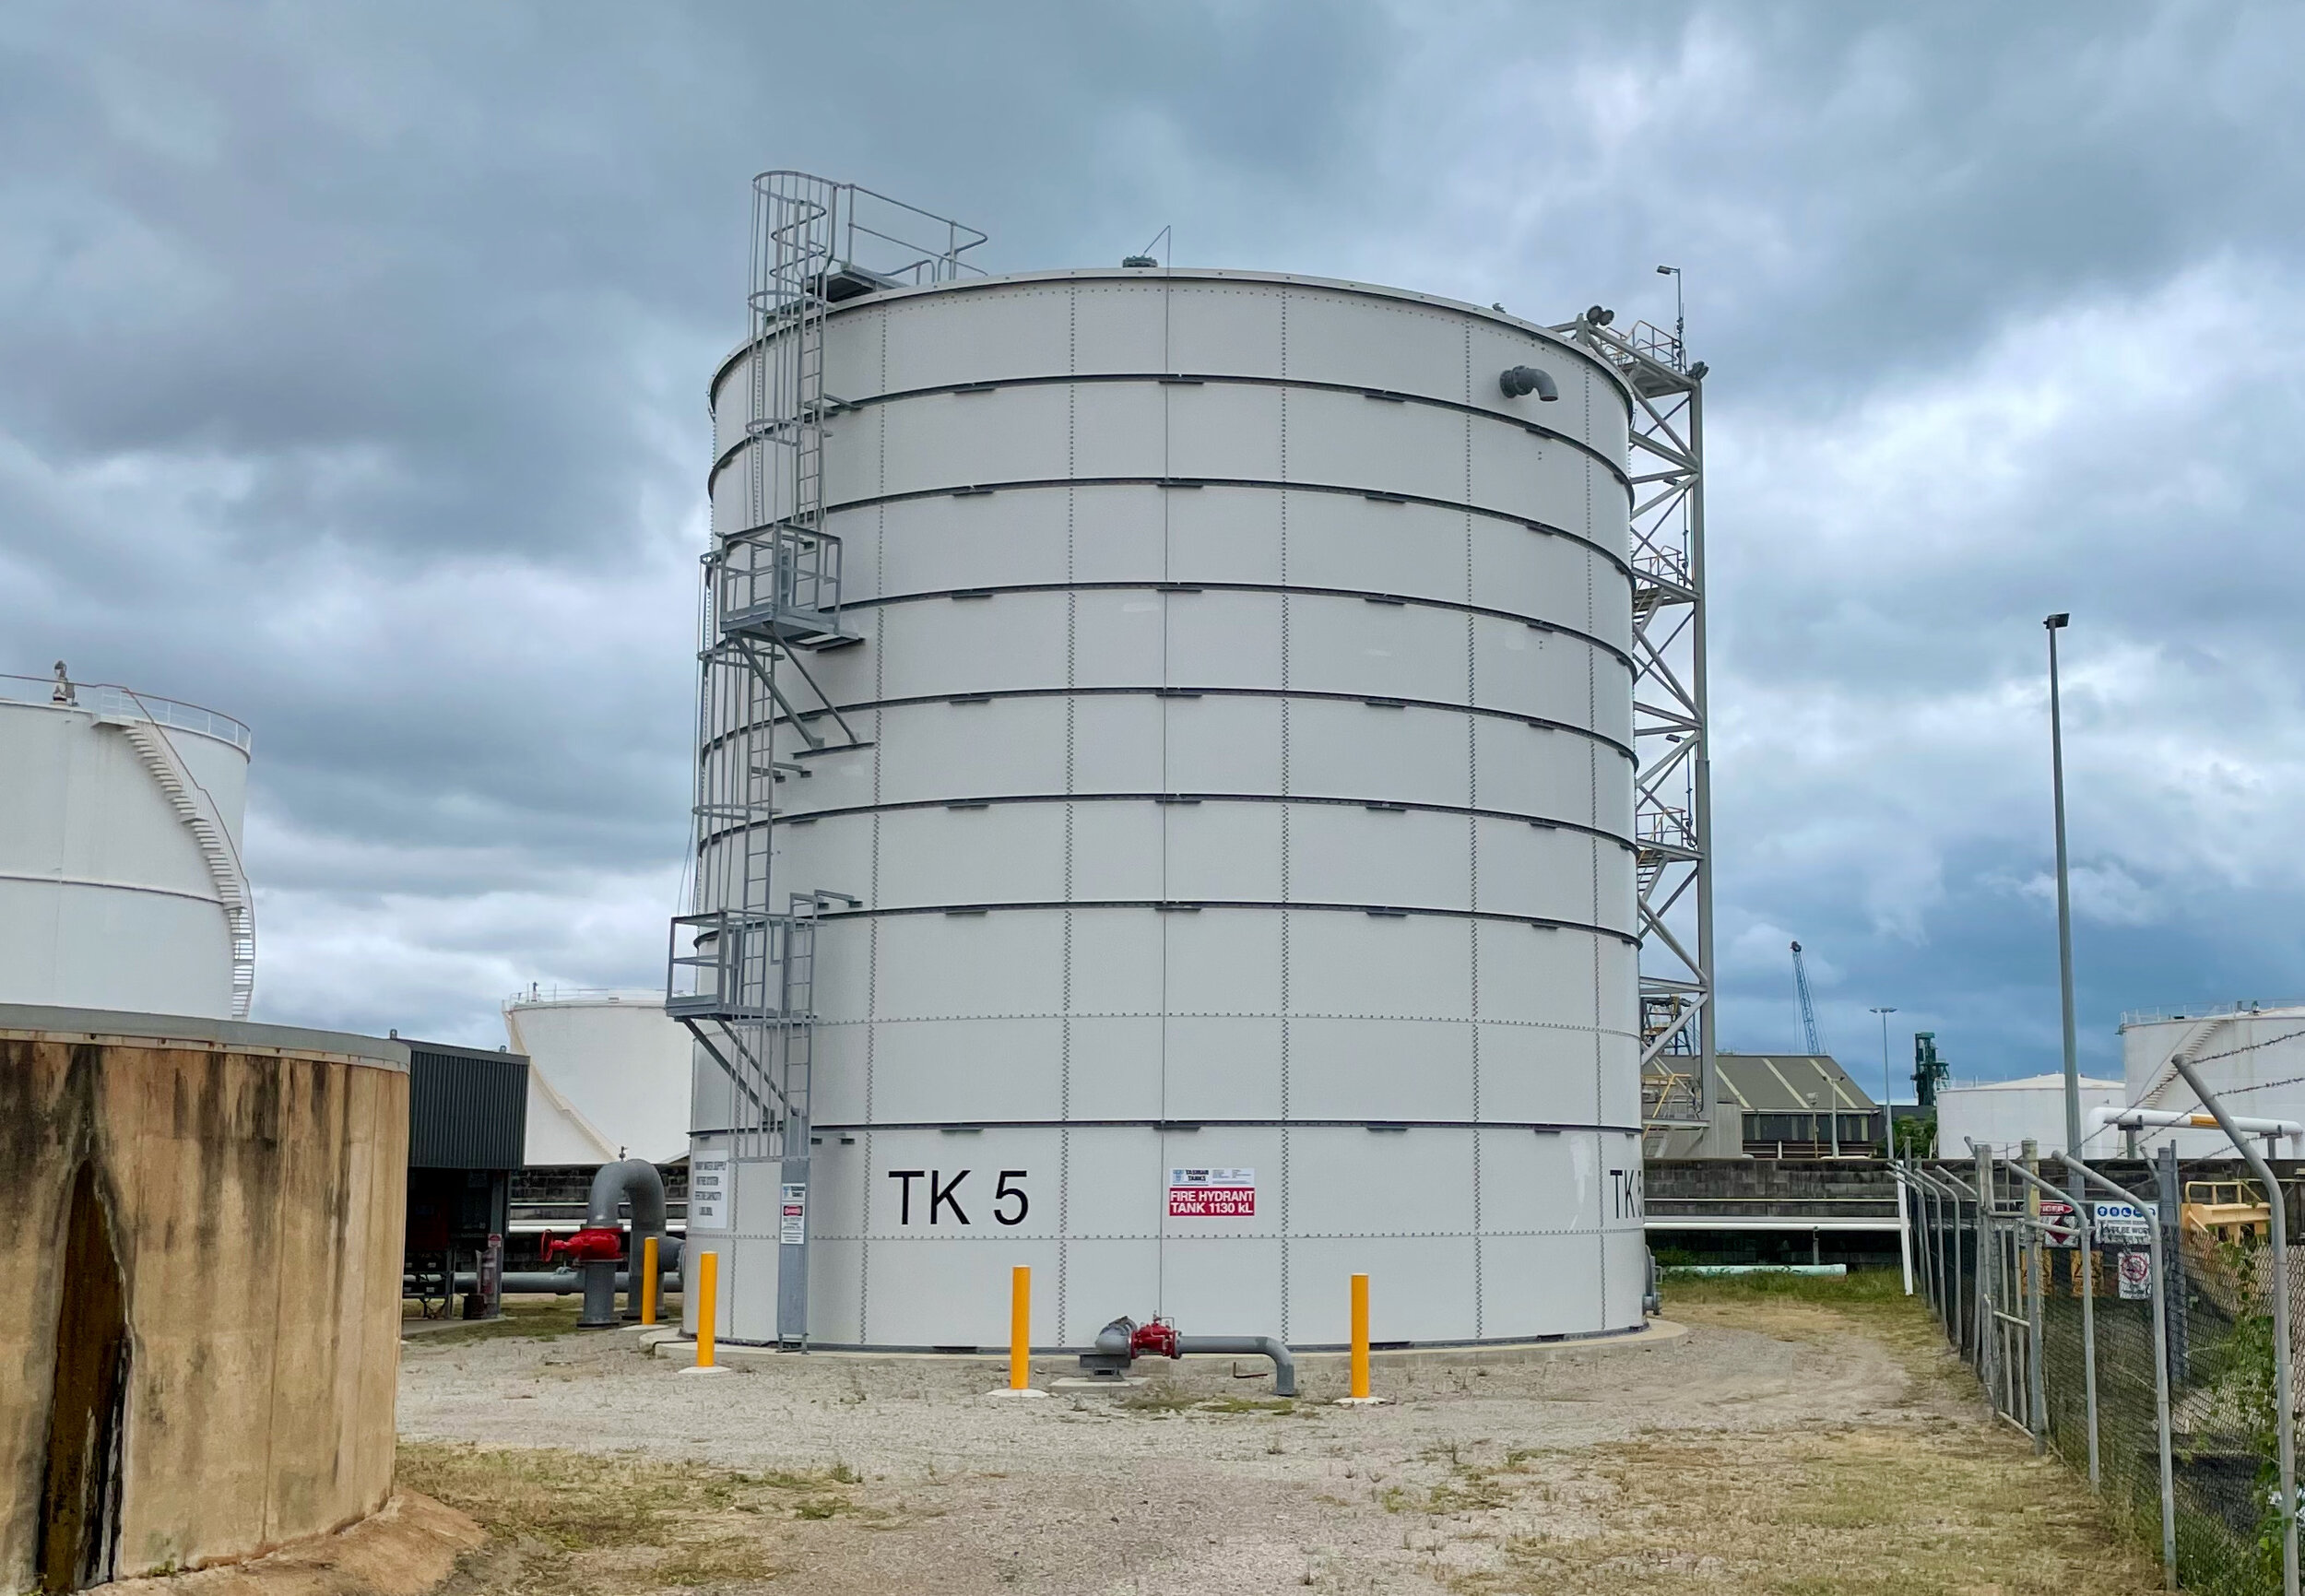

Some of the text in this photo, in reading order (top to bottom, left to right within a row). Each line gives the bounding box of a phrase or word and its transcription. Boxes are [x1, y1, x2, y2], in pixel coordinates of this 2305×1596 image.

[888, 1170, 1029, 1226] TK 5
[1170, 1190, 1254, 1202] FIRE HYDRANT
[1171, 1202, 1253, 1213] TANK 1130 kL
[1610, 1170, 1636, 1219] TK
